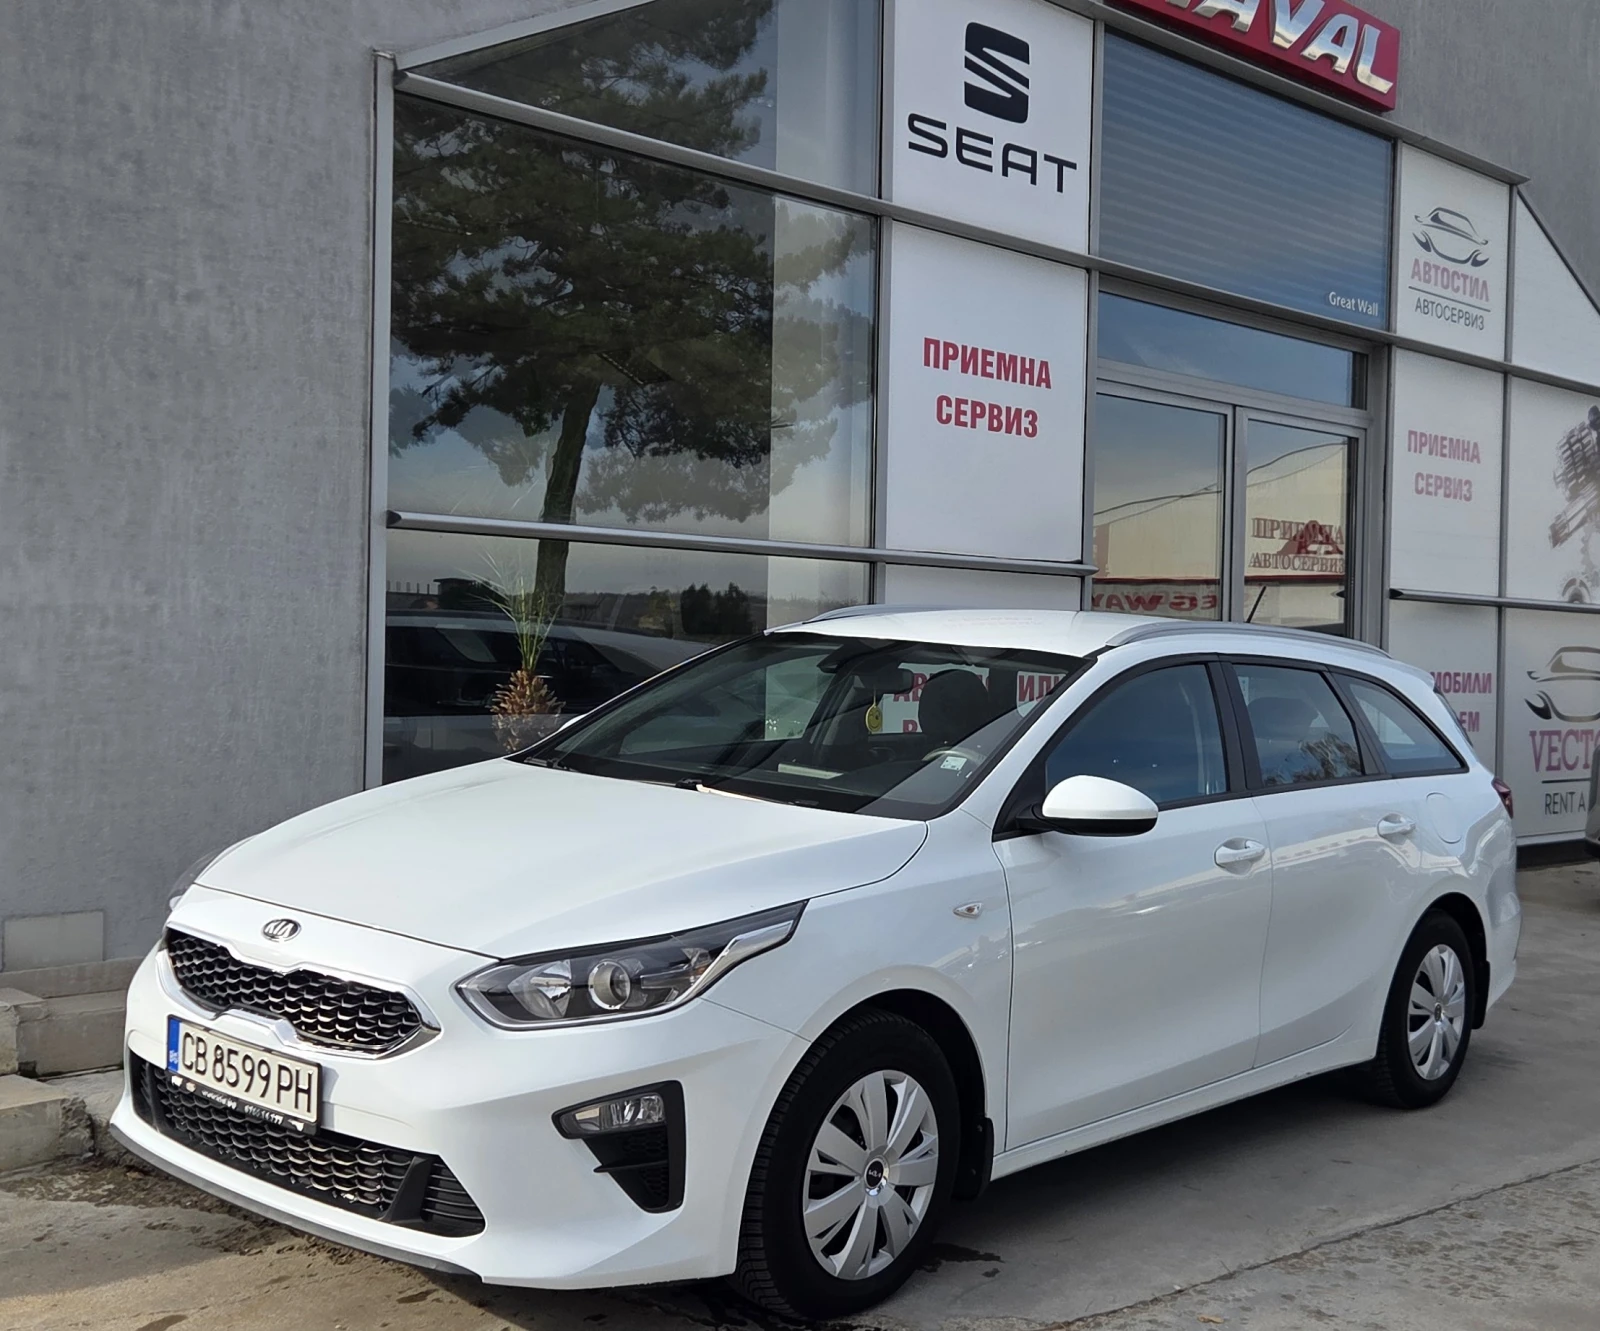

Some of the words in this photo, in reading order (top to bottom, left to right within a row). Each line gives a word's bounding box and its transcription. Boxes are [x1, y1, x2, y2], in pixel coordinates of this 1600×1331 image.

[1164, 0, 1394, 94] AVAL
[907, 112, 1077, 193] SEAT
[1410, 257, 1489, 303] АВТОСТИЛ
[1329, 291, 1355, 311] Great
[1357, 299, 1379, 317] Wall
[1414, 296, 1485, 331] АВТОСЕРВИЗ
[923, 336, 1052, 389] ПРИЕМНА
[936, 394, 1039, 439] СЕРВИЗ
[1407, 429, 1481, 464] ПРИЕМНА
[1414, 471, 1473, 502] СЕРВИЗ
[1529, 728, 1600, 773] VECT
[1544, 791, 1576, 815] RENT
[1578, 790, 1586, 813] A
[212, 1044, 272, 1099] 8599
